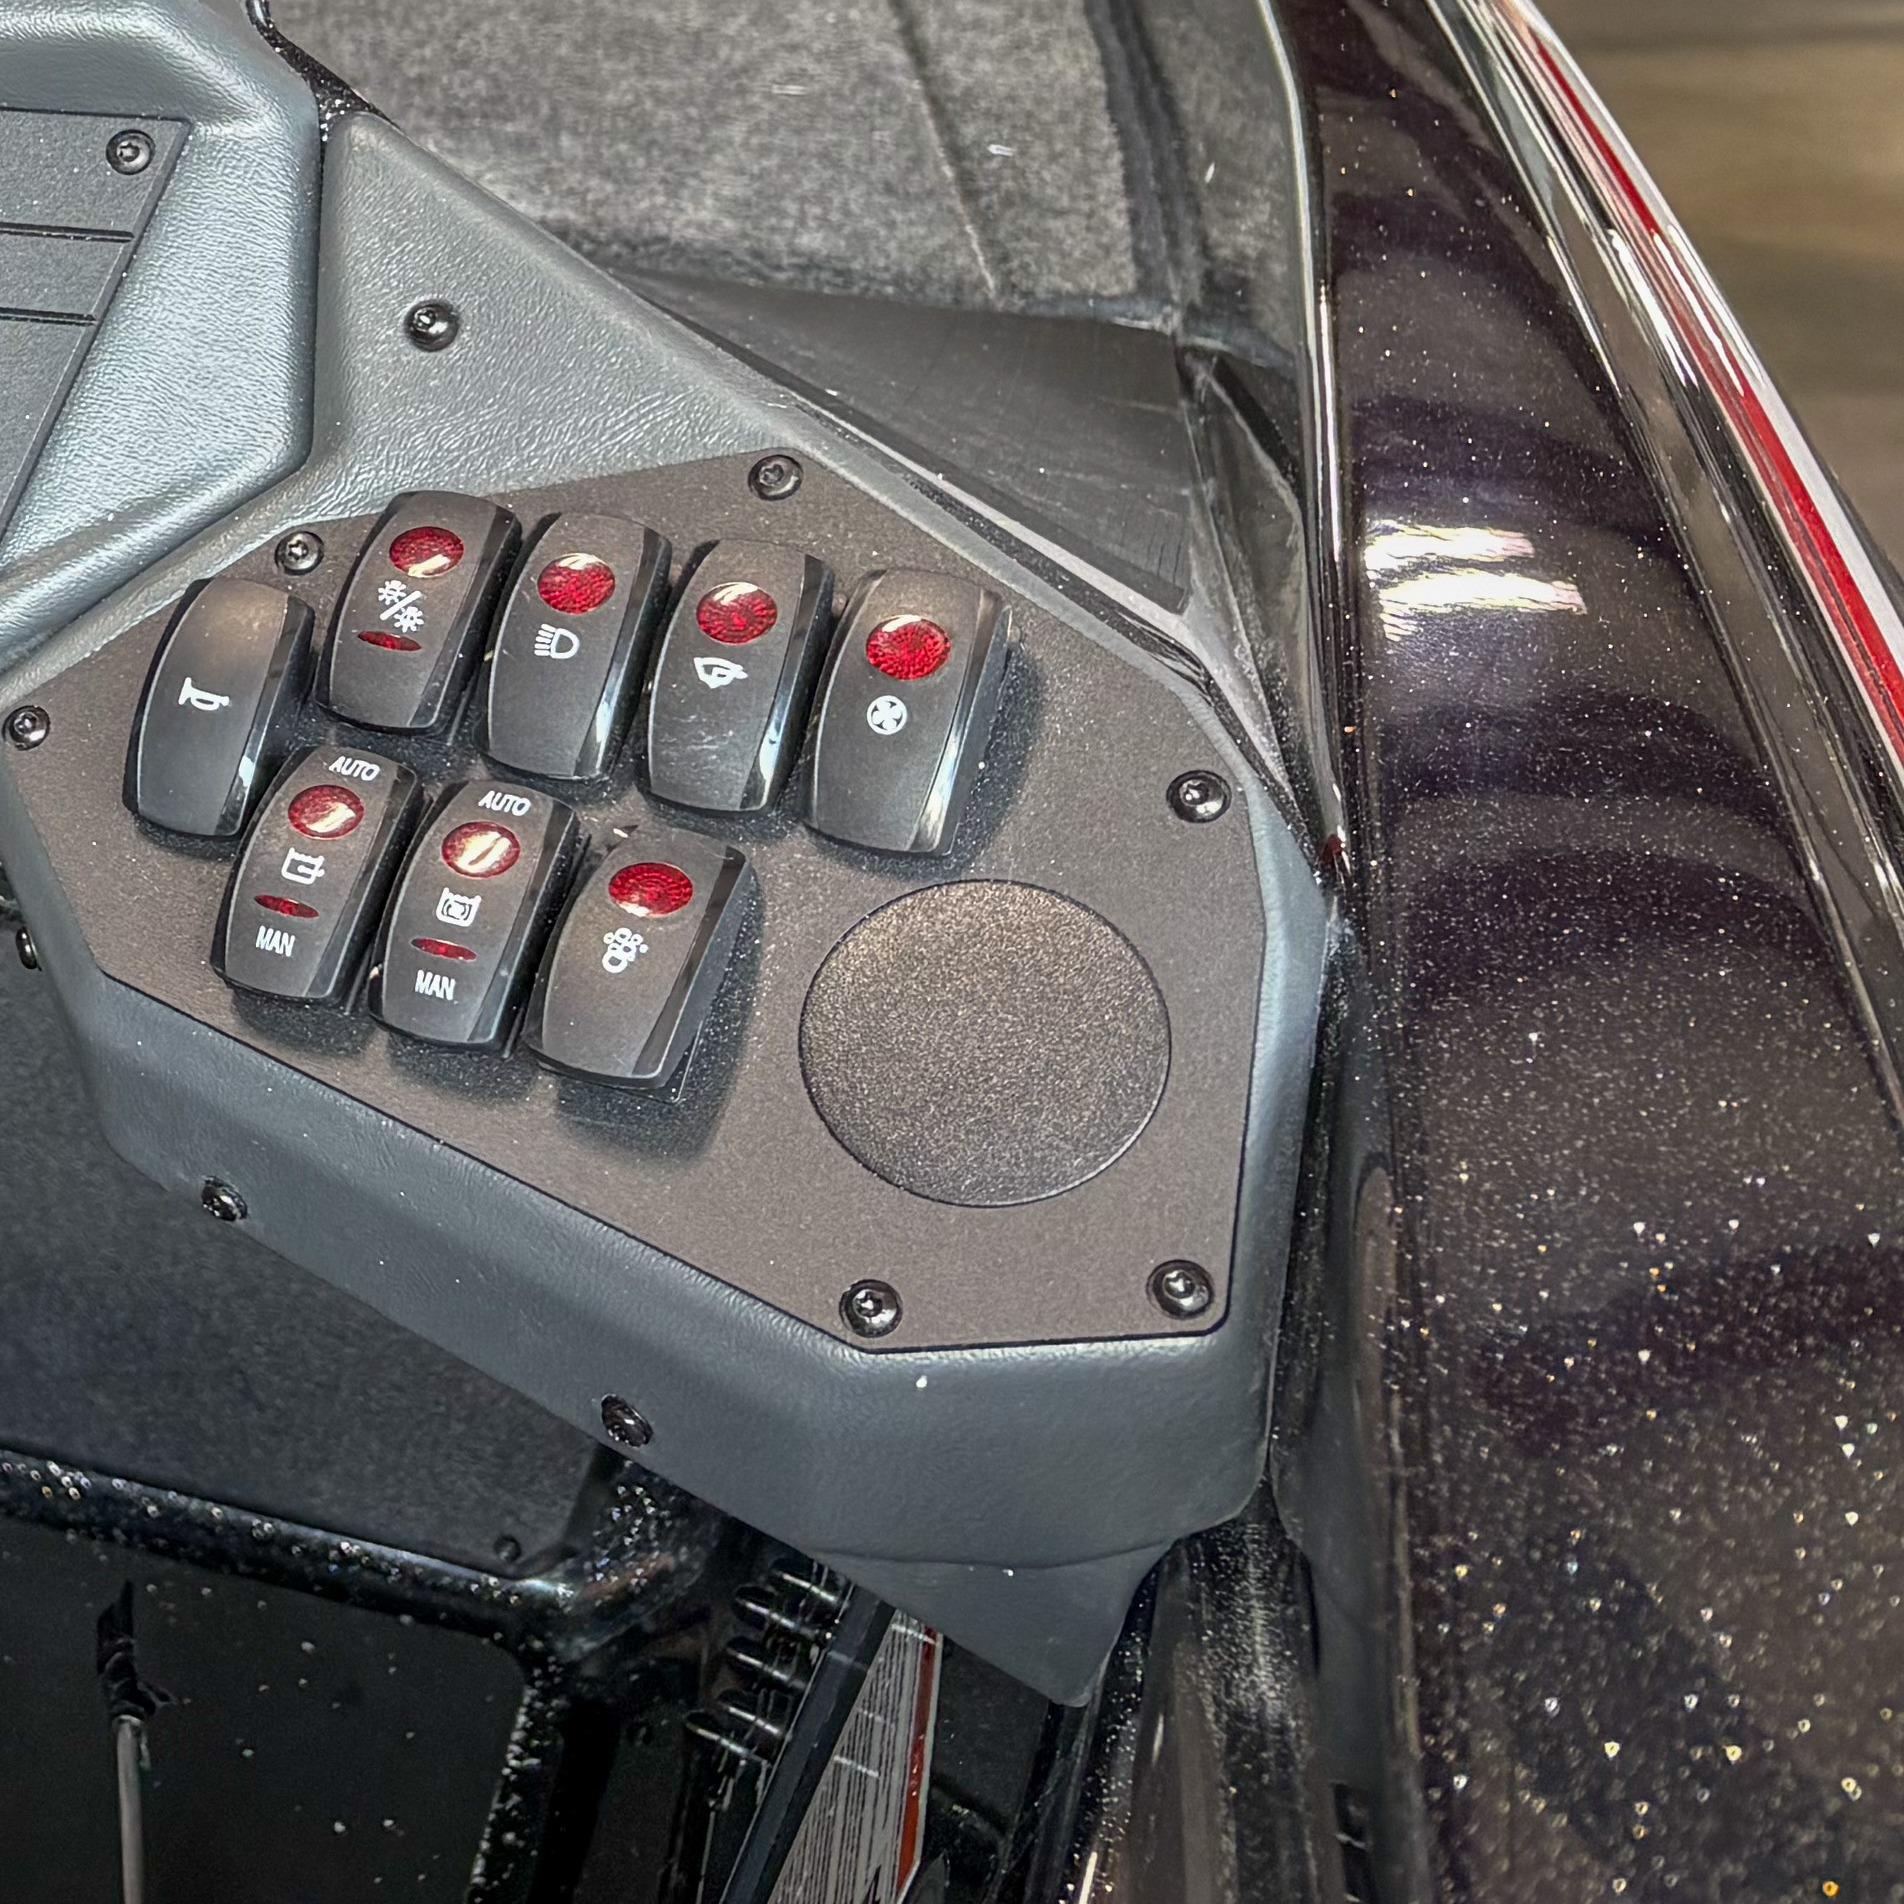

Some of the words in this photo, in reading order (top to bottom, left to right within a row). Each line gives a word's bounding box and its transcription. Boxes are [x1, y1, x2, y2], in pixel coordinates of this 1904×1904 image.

[328, 756, 381, 781] AUTO
[478, 790, 531, 816] AUTO
[255, 925, 295, 957] MAN
[415, 969, 456, 1001] MAN
